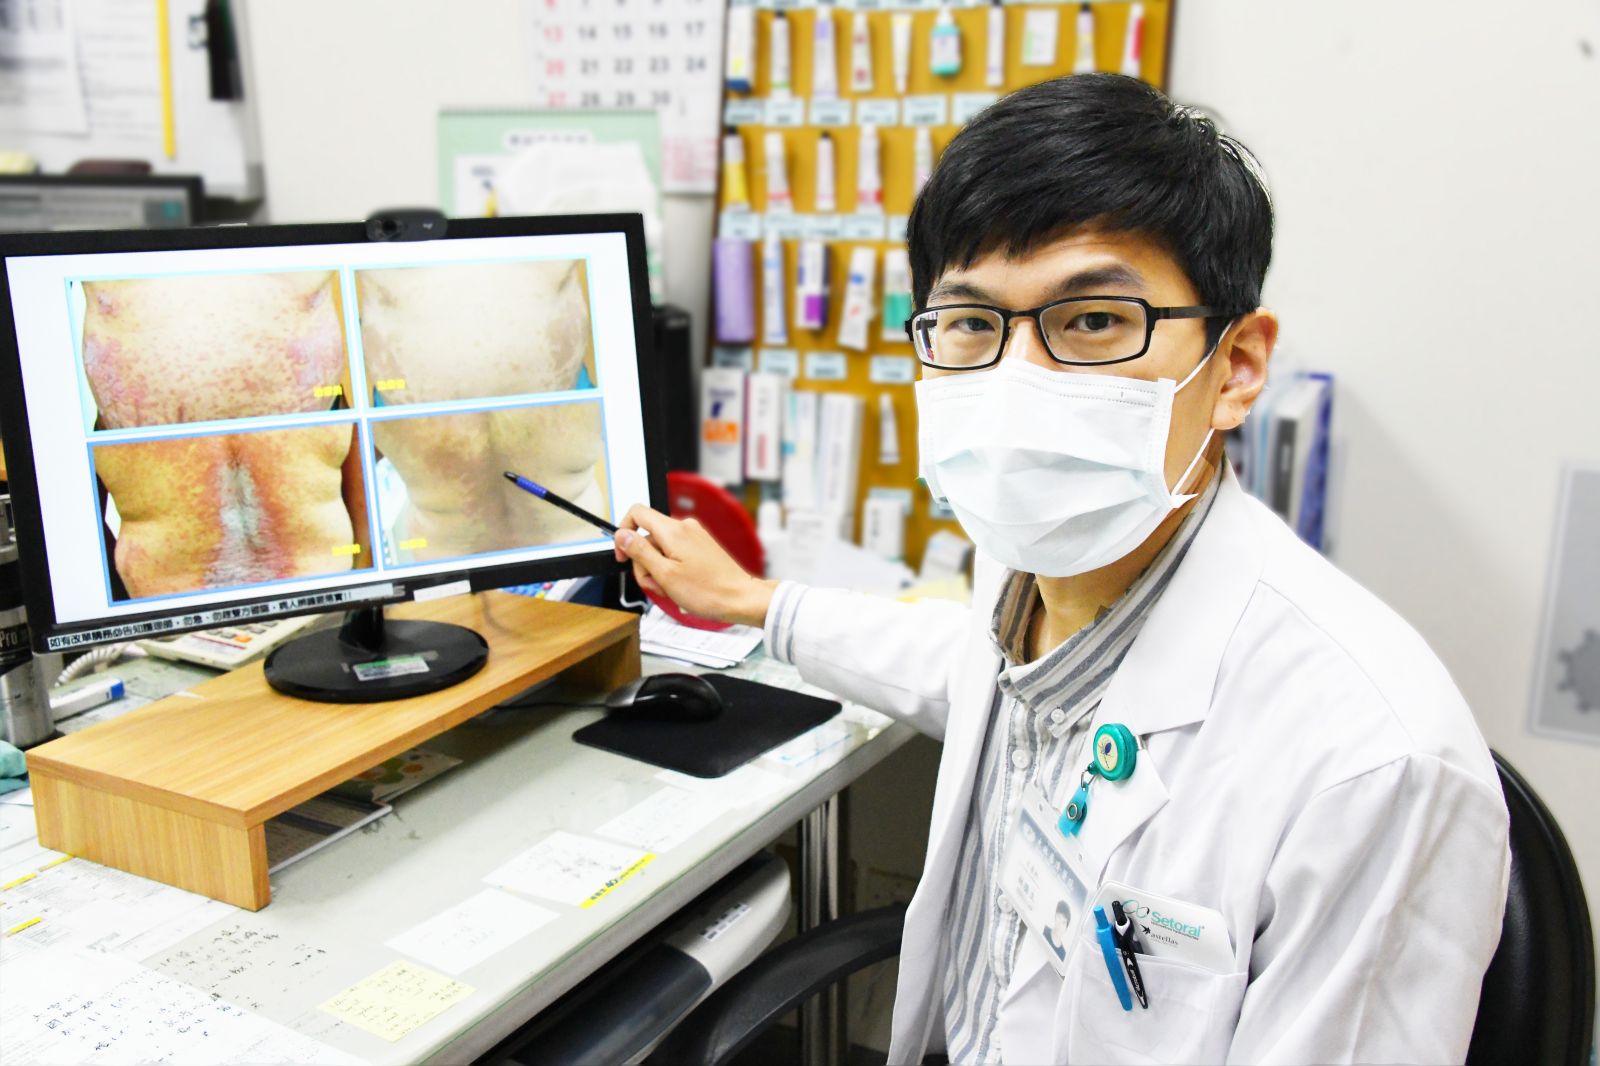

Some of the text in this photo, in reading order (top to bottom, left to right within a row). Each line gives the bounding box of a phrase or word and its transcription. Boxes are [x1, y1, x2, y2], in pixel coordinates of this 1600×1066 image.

[544, 21, 704, 41] 13 14 15 16 17
[580, 59, 598, 74] 21
[614, 58, 633, 74] 22
[650, 57, 670, 72] 23
[685, 57, 706, 72] 24
[581, 92, 600, 107] 28
[616, 91, 635, 106] 29
[1151, 911, 1202, 938] Setoral
